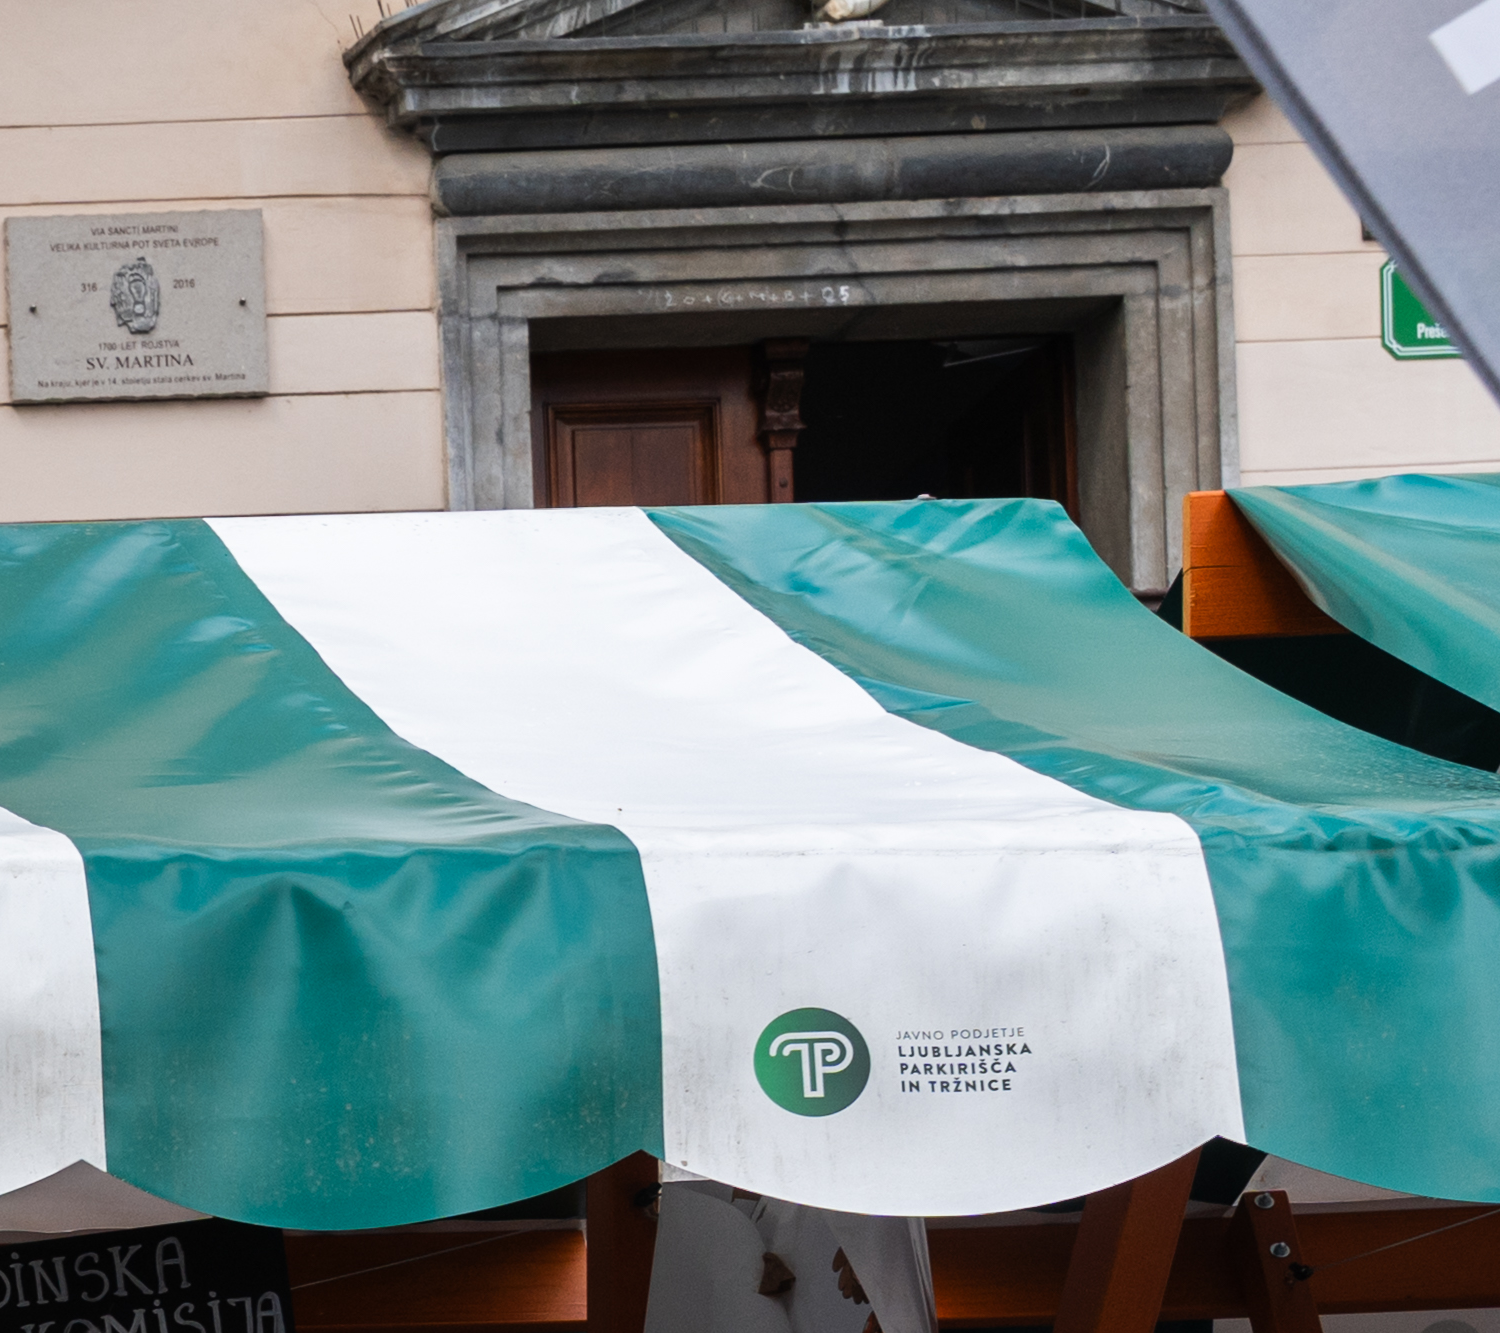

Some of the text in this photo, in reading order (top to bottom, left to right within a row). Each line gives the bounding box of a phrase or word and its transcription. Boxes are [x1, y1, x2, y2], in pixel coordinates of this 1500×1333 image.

[91, 224, 179, 236] VIA SANCTI MARTINI
[50, 237, 219, 253] VELIKA KULTURNA POT SVETA EVROPE
[81, 279, 195, 292] 316 2016
[99, 340, 180, 351] 1700 LET ROJSTVA
[86, 354, 194, 370] SV. MARTINA
[38, 372, 245, 388] Na stala Martina
[896, 1026, 1025, 1041] JAVNO PODJETJE
[898, 1043, 1032, 1058] LJUBLJANSKA
[900, 1058, 1017, 1075] PARKIRIŠČA
[901, 1077, 1012, 1093] IN TRŽNICE
